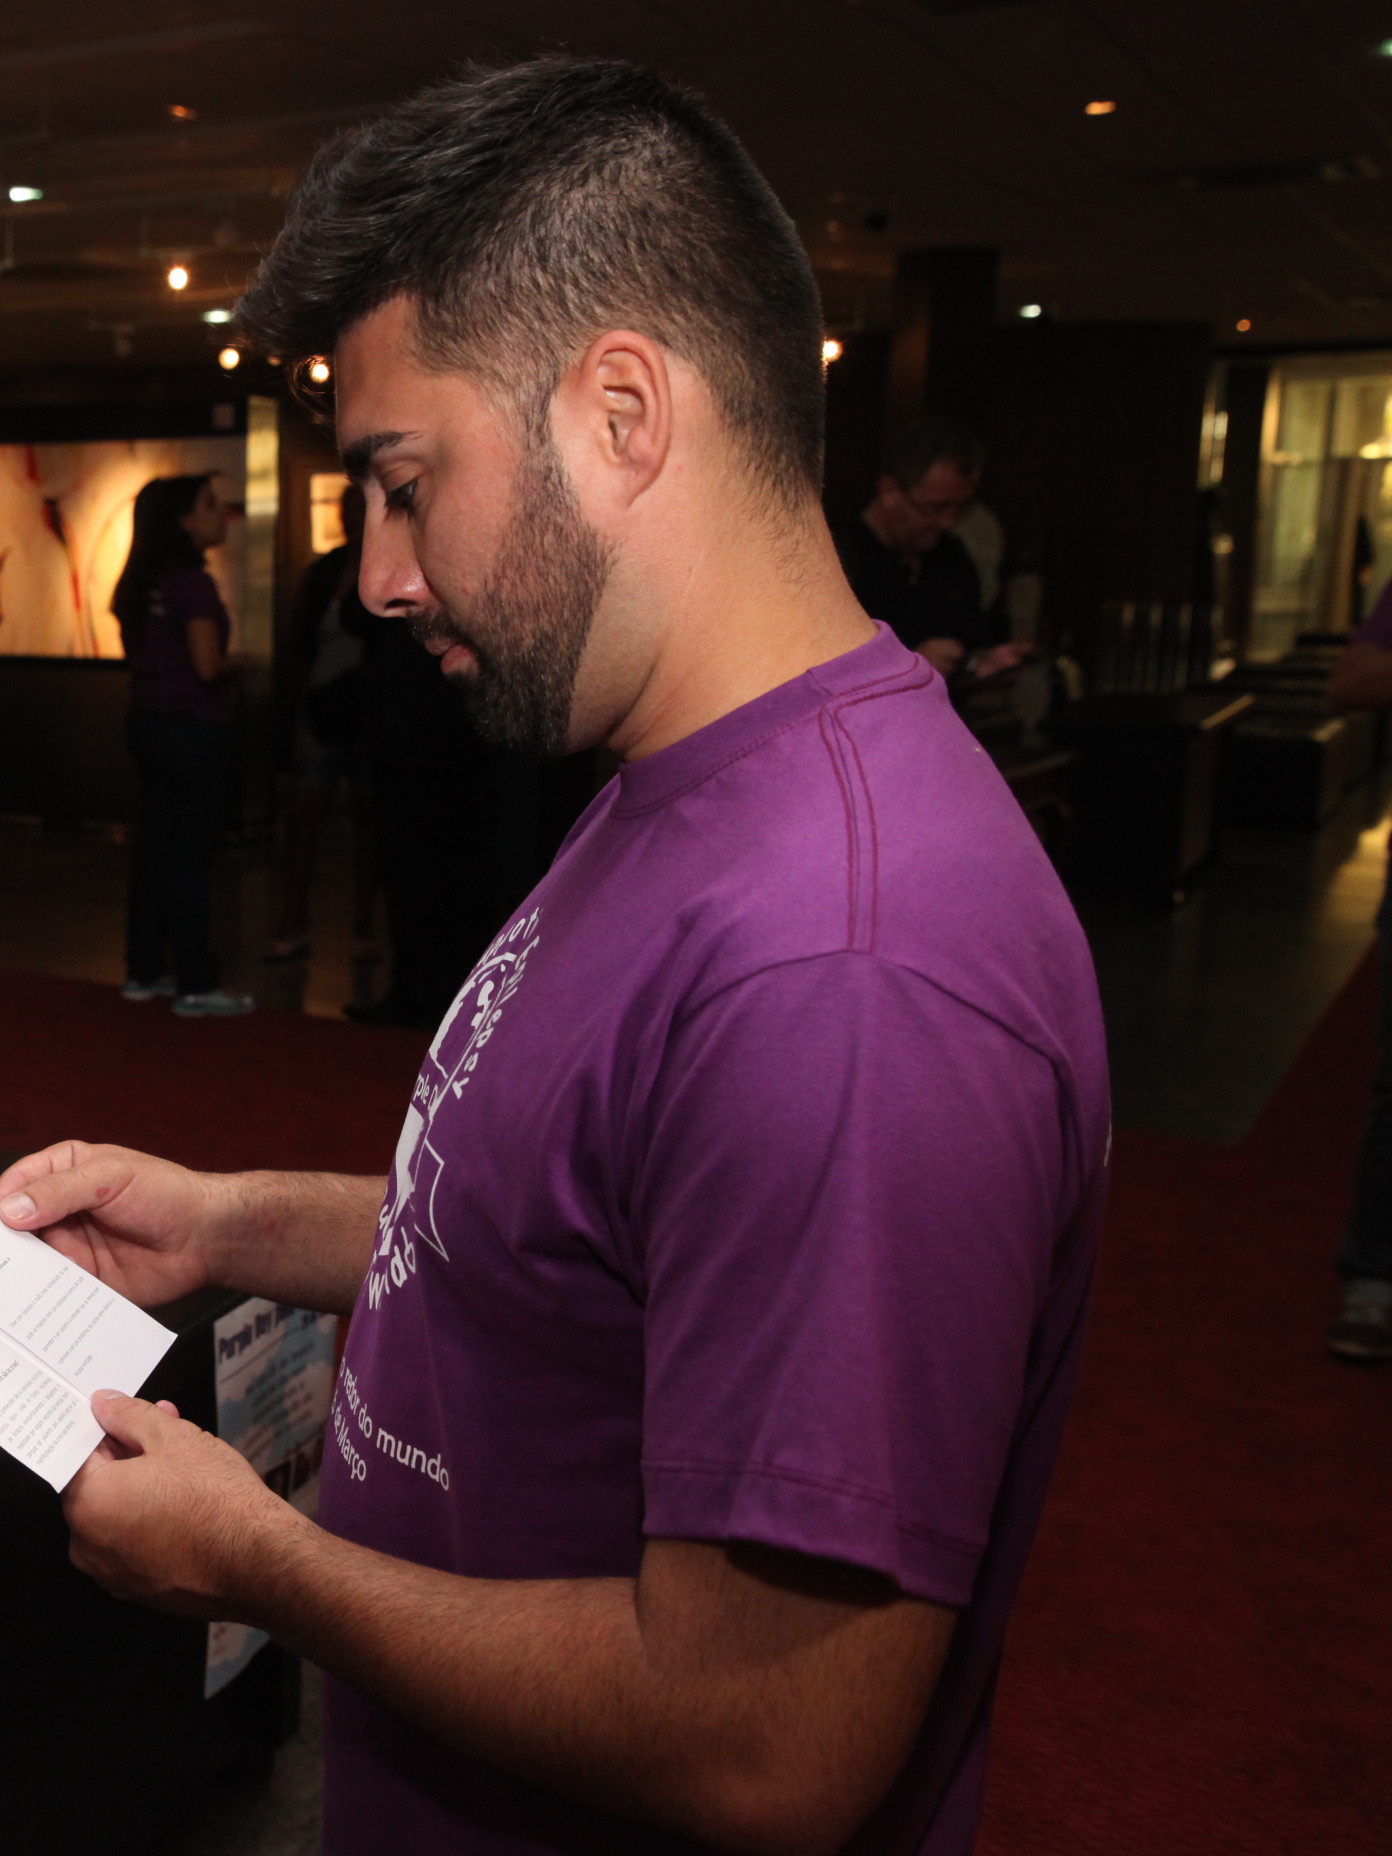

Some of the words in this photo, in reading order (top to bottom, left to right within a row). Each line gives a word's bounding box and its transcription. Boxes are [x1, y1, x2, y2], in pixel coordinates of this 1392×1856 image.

[337, 1417, 367, 1482] Março
[343, 1366, 361, 1415] redor
[358, 1403, 373, 1439] do
[376, 1427, 449, 1491] mundo
